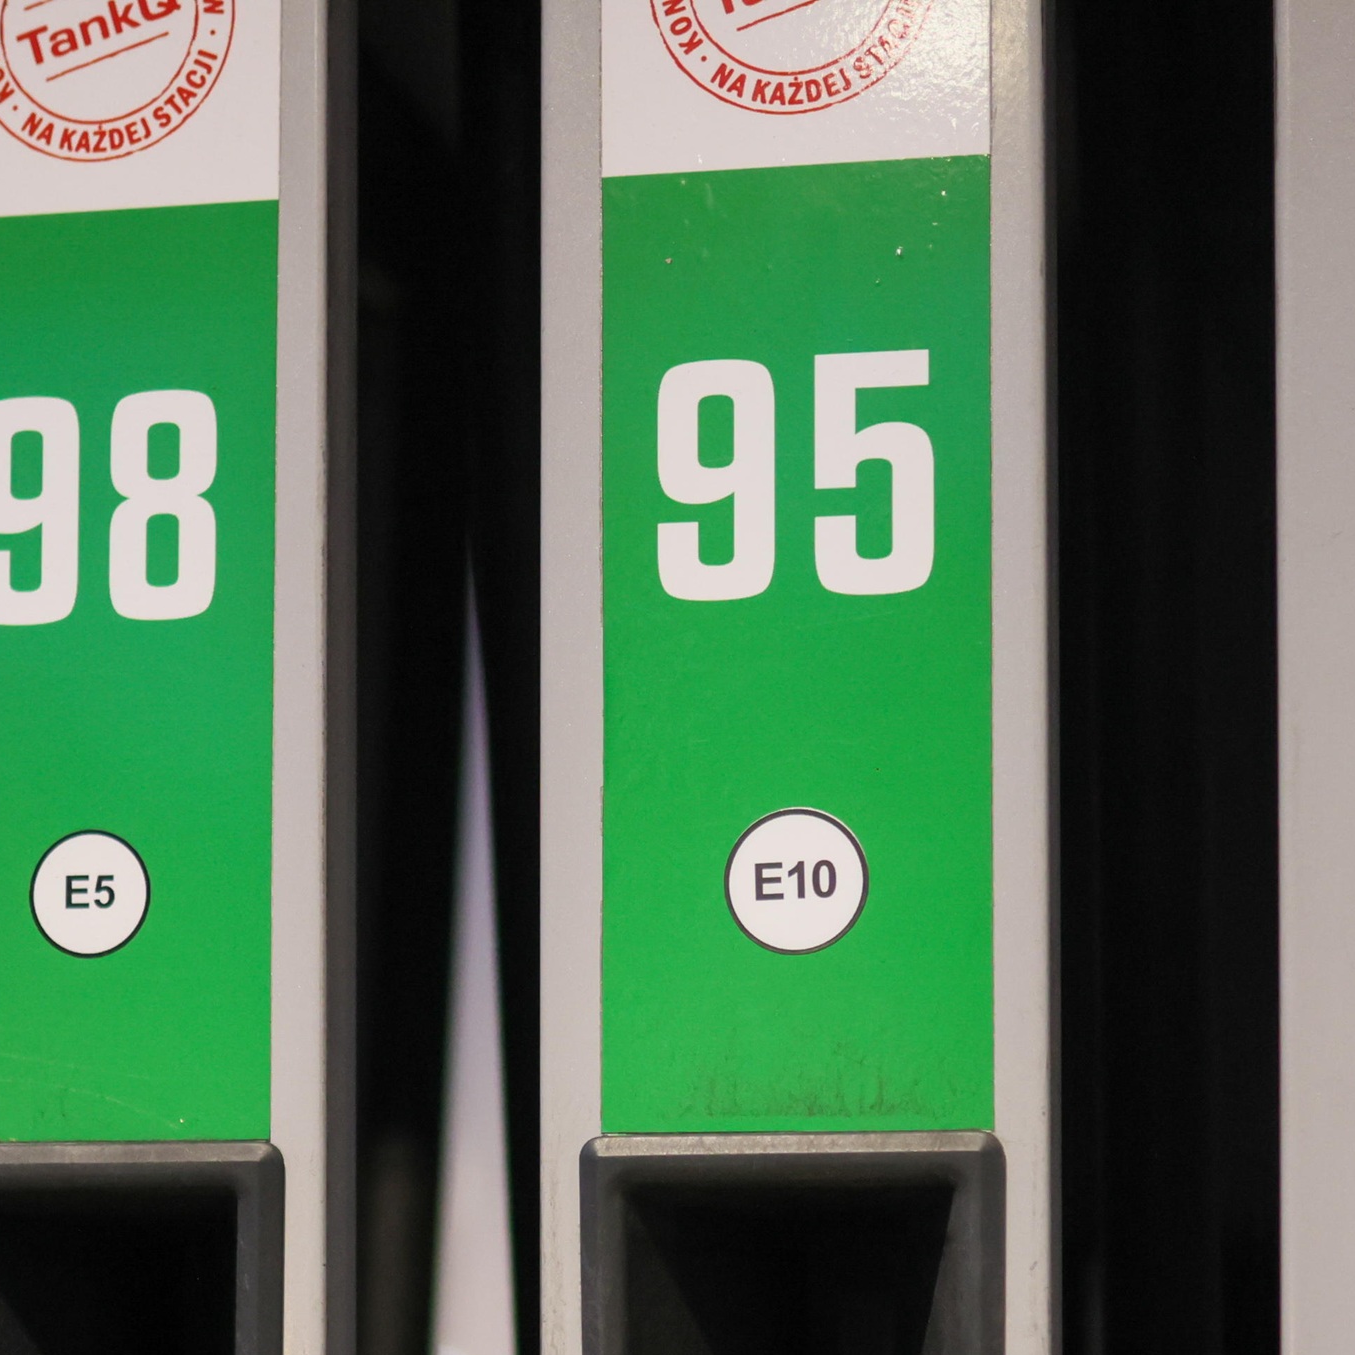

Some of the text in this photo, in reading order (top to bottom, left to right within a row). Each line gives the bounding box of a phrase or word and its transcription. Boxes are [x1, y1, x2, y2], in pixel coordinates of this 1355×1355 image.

[21, 49, 218, 153] NA KAŻDEJ STACJI
[710, 62, 748, 98] NA
[751, 68, 852, 106] KAŻDEJ
[656, 349, 935, 602] 95
[65, 874, 115, 909] E5
[754, 859, 837, 901] E10
